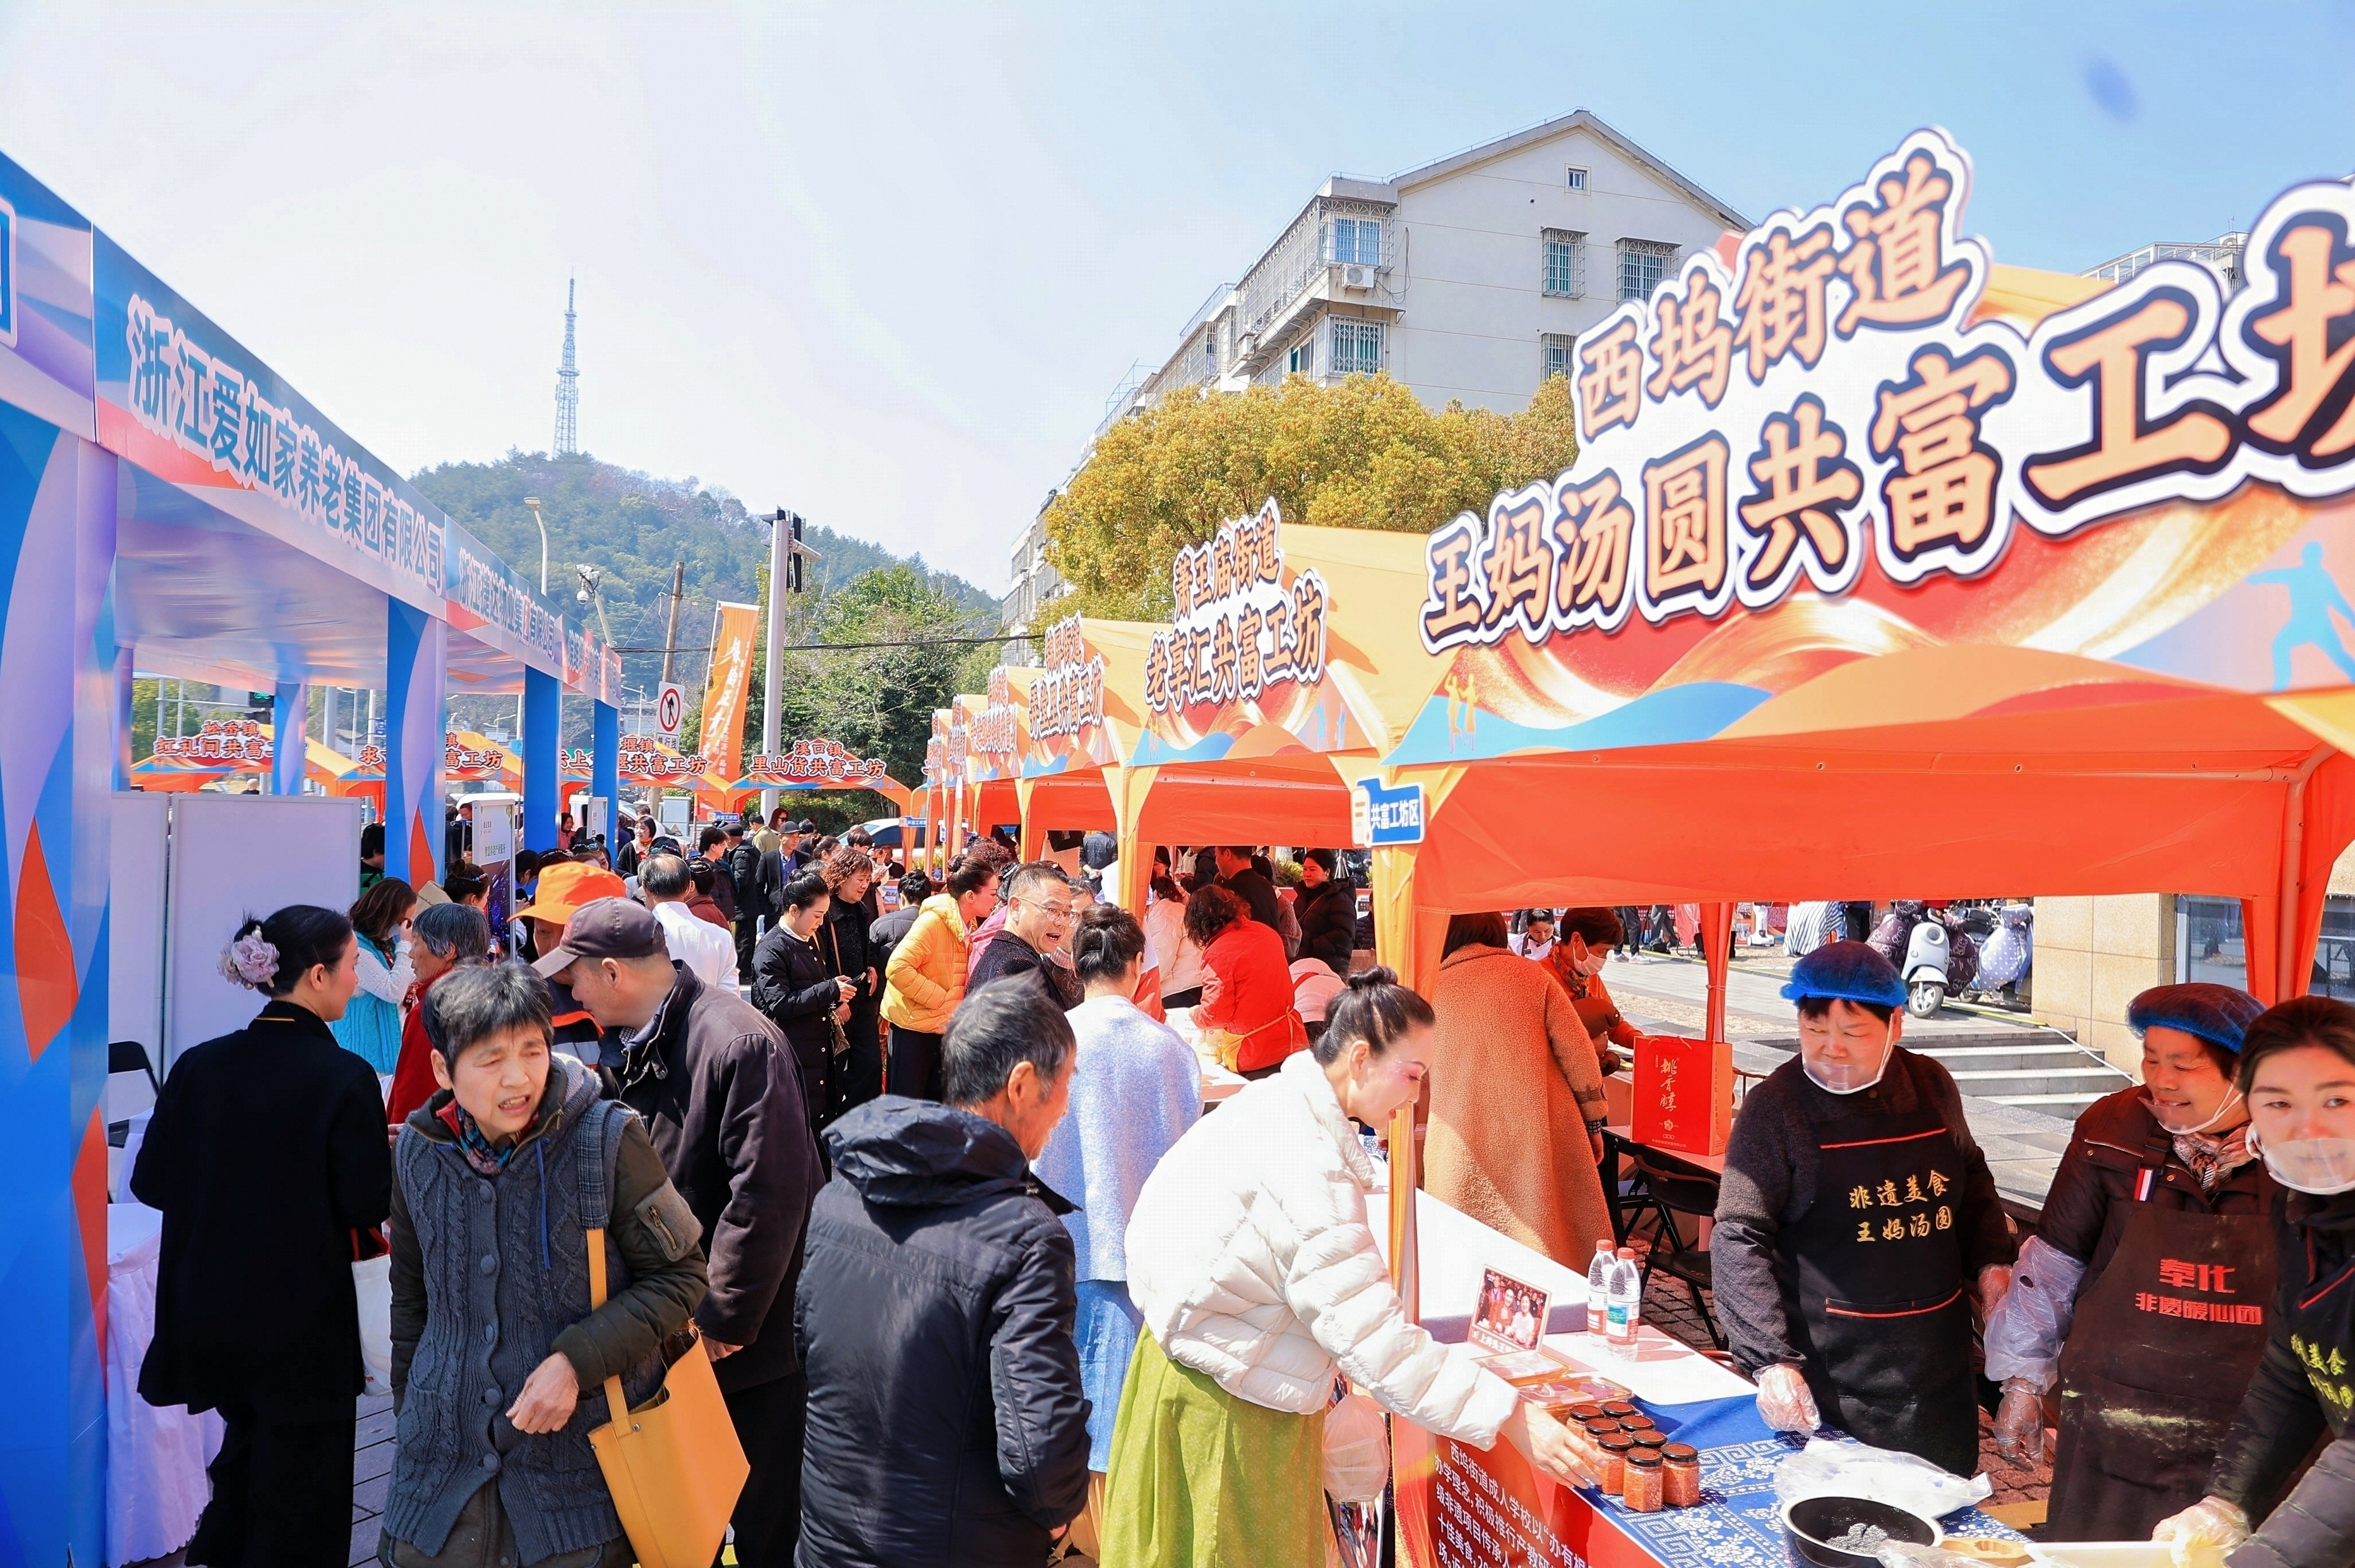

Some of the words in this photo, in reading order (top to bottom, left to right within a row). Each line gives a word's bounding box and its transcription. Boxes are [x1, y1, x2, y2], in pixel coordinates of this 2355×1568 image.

[1580, 148, 1969, 440] 西坞街道
[130, 301, 443, 595] 浙江爱如家养老集团有限公司
[1175, 506, 1279, 619] 萧王庙街道
[1147, 579, 1322, 703] 老享汇共富工坊
[1029, 659, 1102, 735] 弄堂里共富工坊
[751, 756, 885, 777] 里山货共富工坊
[795, 741, 844, 758] 溪口镇
[1371, 798, 1419, 829] 共富工坊区
[1848, 1169, 1951, 1209] 非遗美食
[1856, 1205, 1953, 1242] 王妈汤圆
[2135, 1292, 2262, 1325] 非遗暖心团
[2159, 1259, 2235, 1294] 奉化
[1435, 1454, 1555, 1568] 办学理念，积极推行产教研
[1436, 1482, 1521, 1568] 级非遗项目传承人
[1450, 1440, 1592, 1568] 西坞街道成人学校以“办有相
